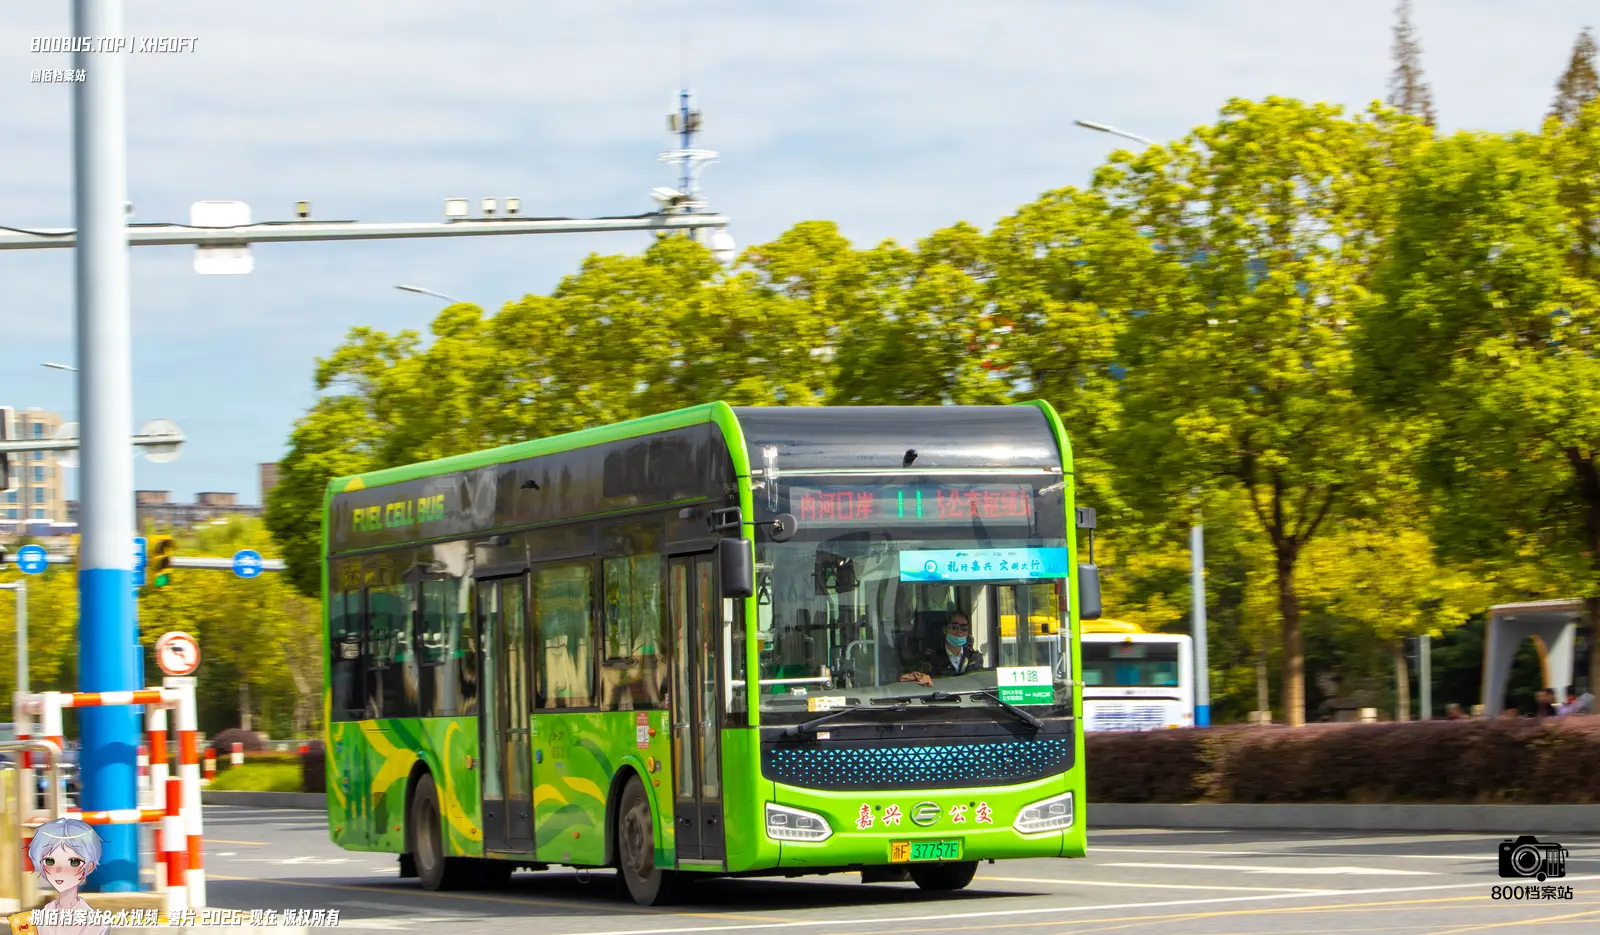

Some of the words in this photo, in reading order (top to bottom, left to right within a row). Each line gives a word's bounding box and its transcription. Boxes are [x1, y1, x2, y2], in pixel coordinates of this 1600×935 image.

[352, 505, 383, 532] FUEL
[385, 500, 415, 528] CELL
[417, 494, 445, 523] BUS
[801, 490, 873, 520] 内河口岸
[897, 490, 922, 518] 11
[1012, 670, 1039, 682] 11路
[856, 803, 902, 830] 嘉兴
[949, 801, 993, 824] 公交
